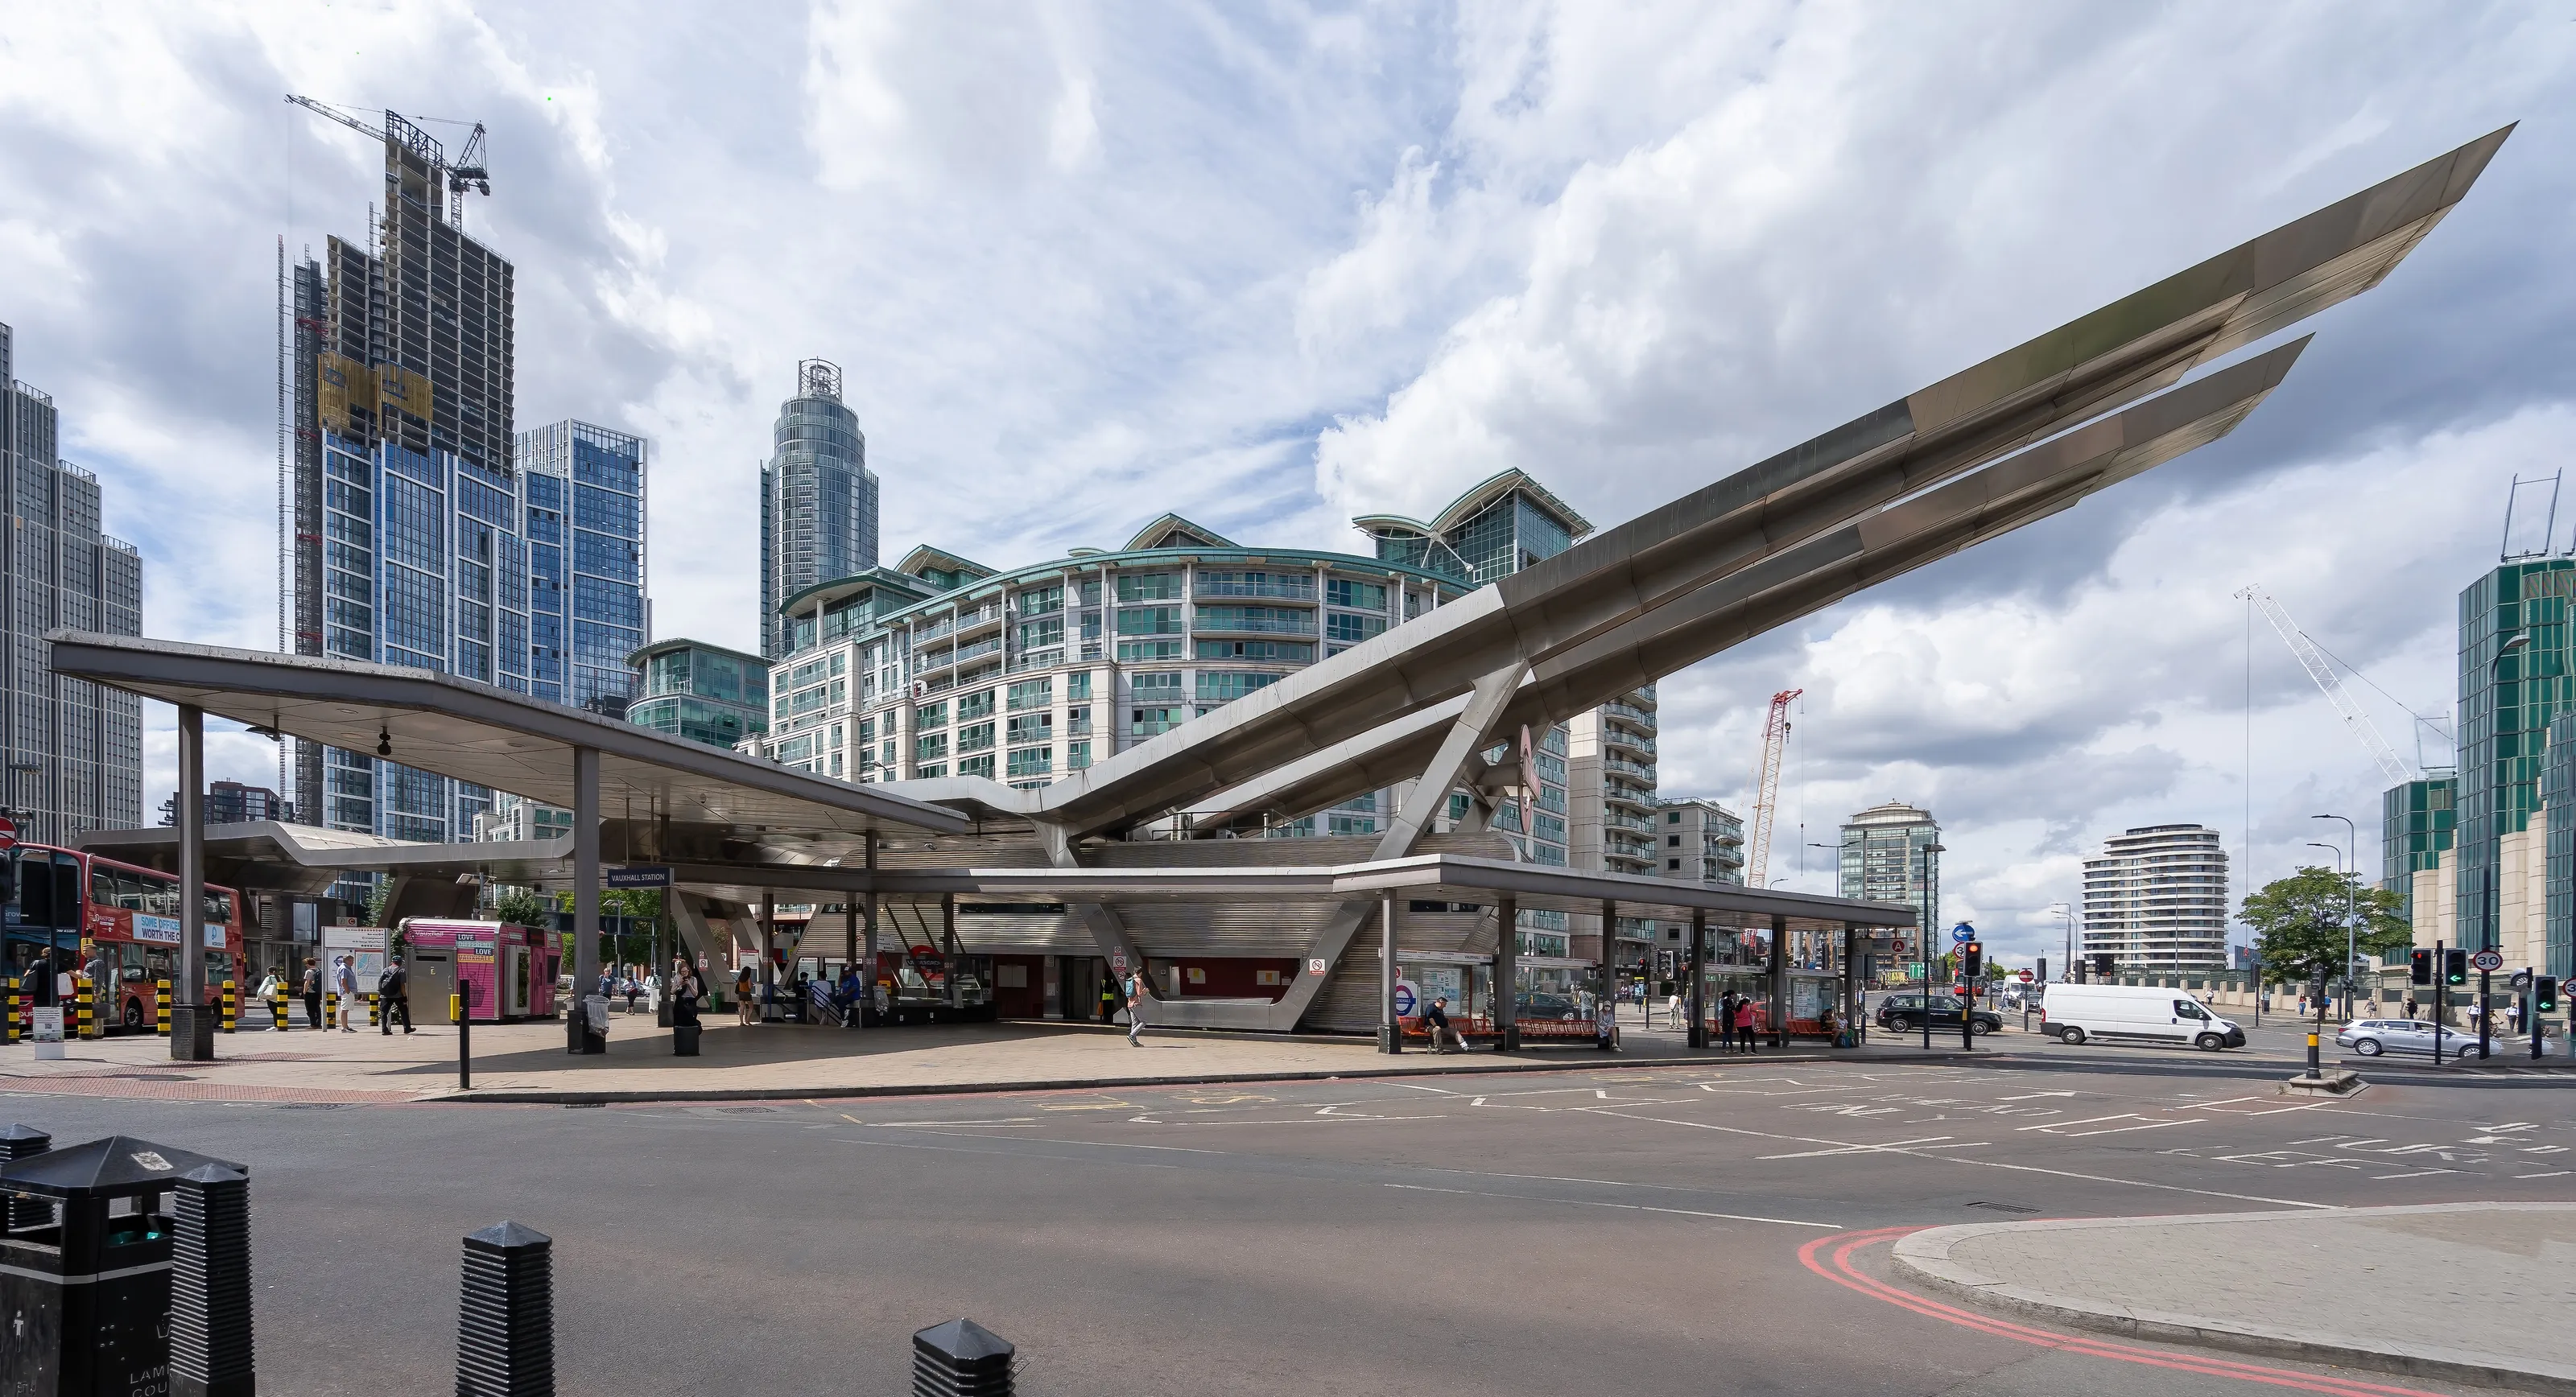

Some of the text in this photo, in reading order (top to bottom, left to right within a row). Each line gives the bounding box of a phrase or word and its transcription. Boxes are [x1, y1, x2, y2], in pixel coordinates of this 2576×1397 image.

[642, 873, 665, 881] STATION
[141, 916, 158, 927] SOME
[142, 927, 162, 940] WORTH
[164, 931, 175, 941] THE
[1895, 942, 1902, 950] A
[2477, 956, 2499, 966] 30
[2566, 983, 2576, 992] 3
